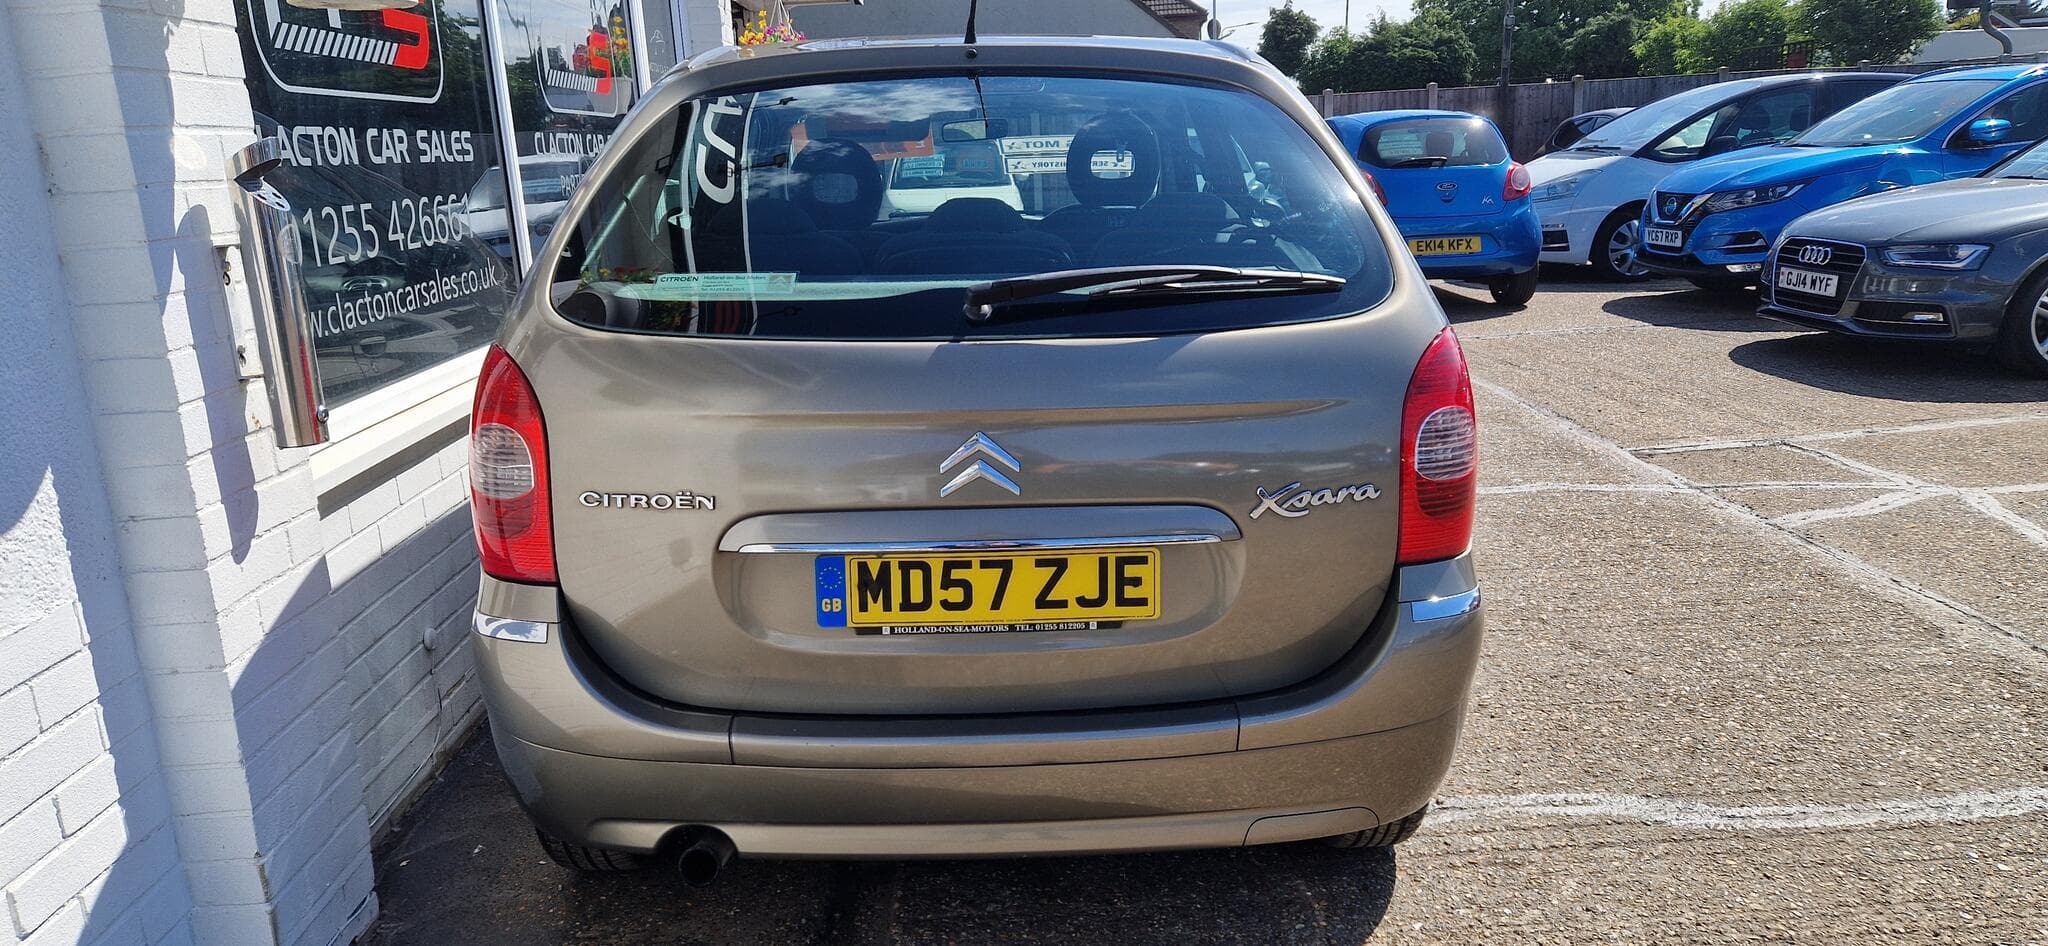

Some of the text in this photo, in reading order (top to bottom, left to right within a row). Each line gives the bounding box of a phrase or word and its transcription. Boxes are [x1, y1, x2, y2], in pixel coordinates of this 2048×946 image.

[255, 124, 474, 167] ACTON CAR SALES
[534, 131, 585, 158] CLACTON
[388, 192, 474, 251] 426661
[1416, 238, 1473, 252] EK14 KFX
[1665, 231, 1679, 243] RXP
[1786, 271, 1833, 292] GJ14 WYF
[310, 256, 498, 341] w.clactoncarsales.co.uk
[578, 490, 716, 510] CITROËN
[1249, 482, 1381, 520] Xsara
[857, 555, 1149, 613] MD57 ZJE
[821, 598, 842, 612] GB
[1015, 623, 1033, 632] TEL:
[1035, 623, 1058, 631] 01255
[1059, 622, 1086, 631] 812205
